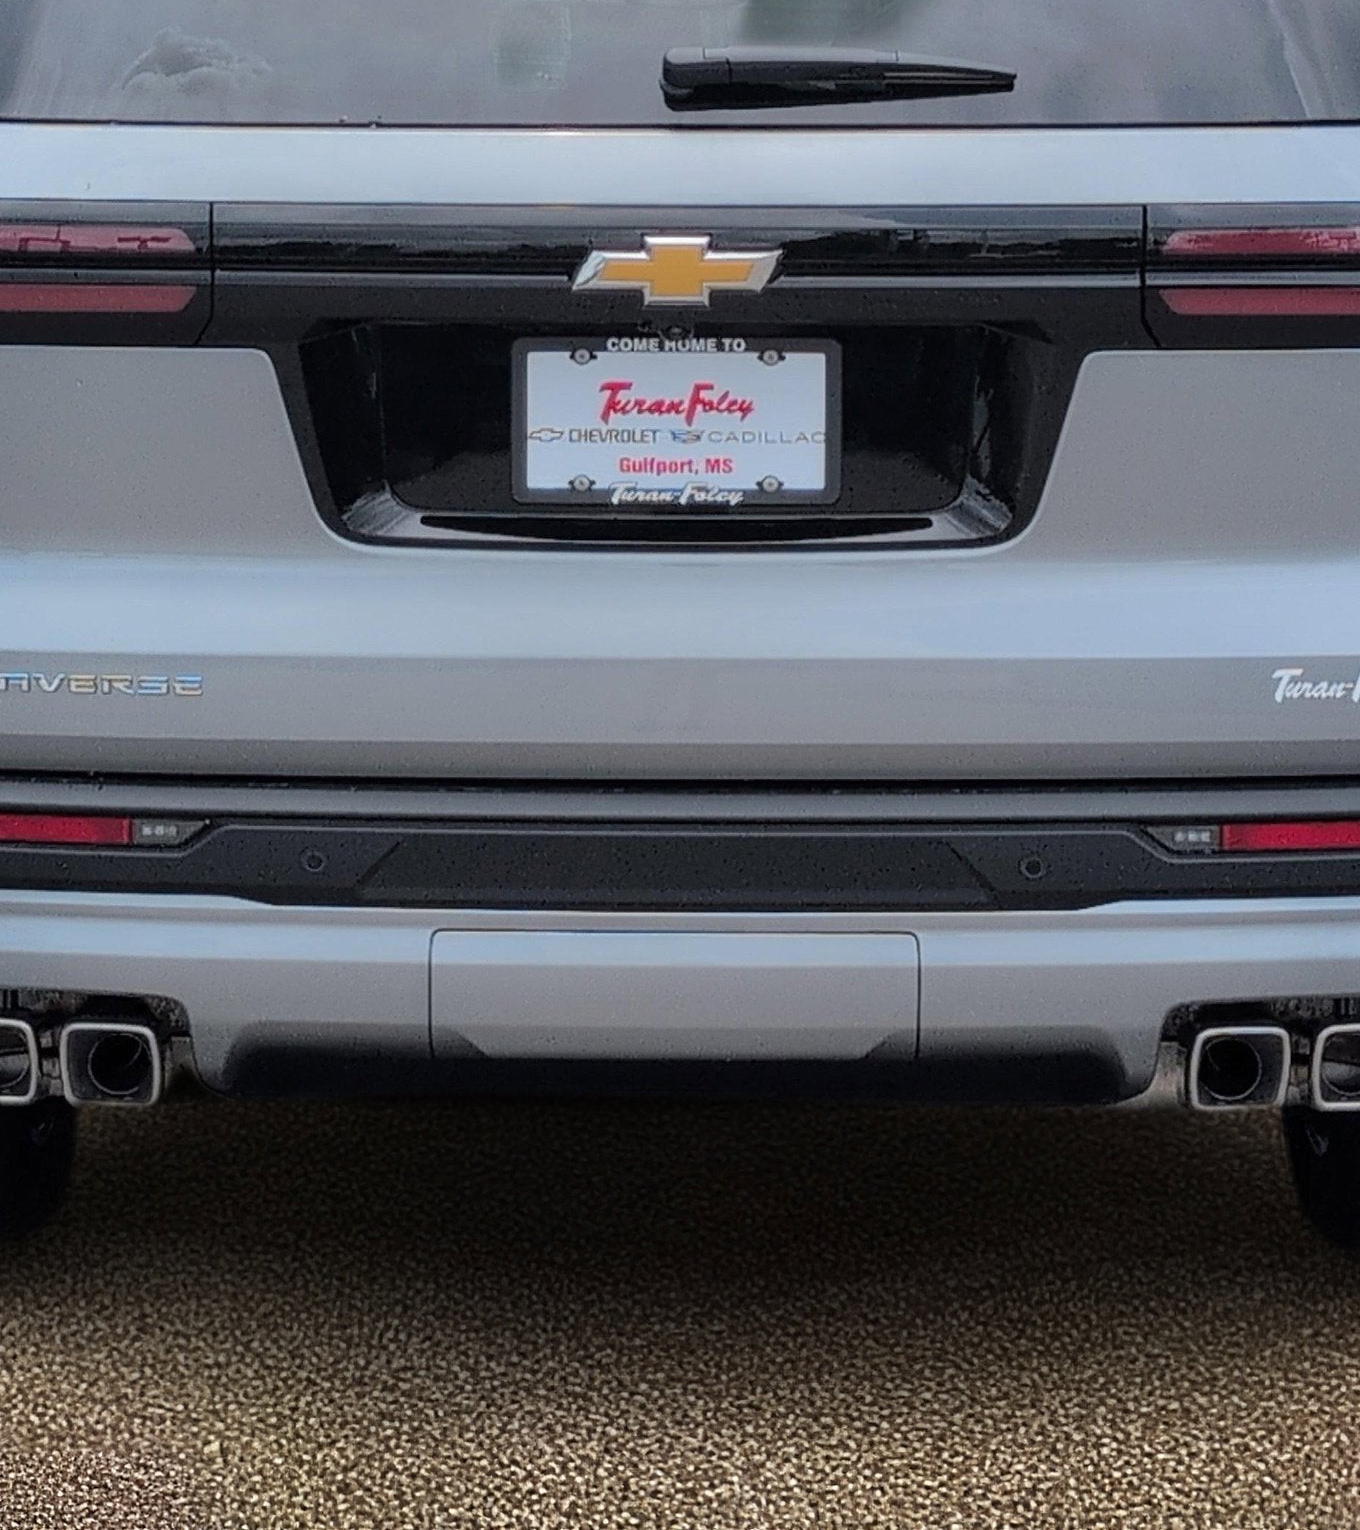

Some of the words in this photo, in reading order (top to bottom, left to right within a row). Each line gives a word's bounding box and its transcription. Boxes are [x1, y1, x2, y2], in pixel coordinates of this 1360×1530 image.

[606, 337, 660, 352] COME
[664, 337, 717, 352] HOME
[721, 337, 747, 352] TO
[568, 429, 660, 444] CHEVROLET
[708, 430, 827, 444] CADILLAC
[619, 456, 699, 476] Gulfport,
[705, 457, 733, 474] MS
